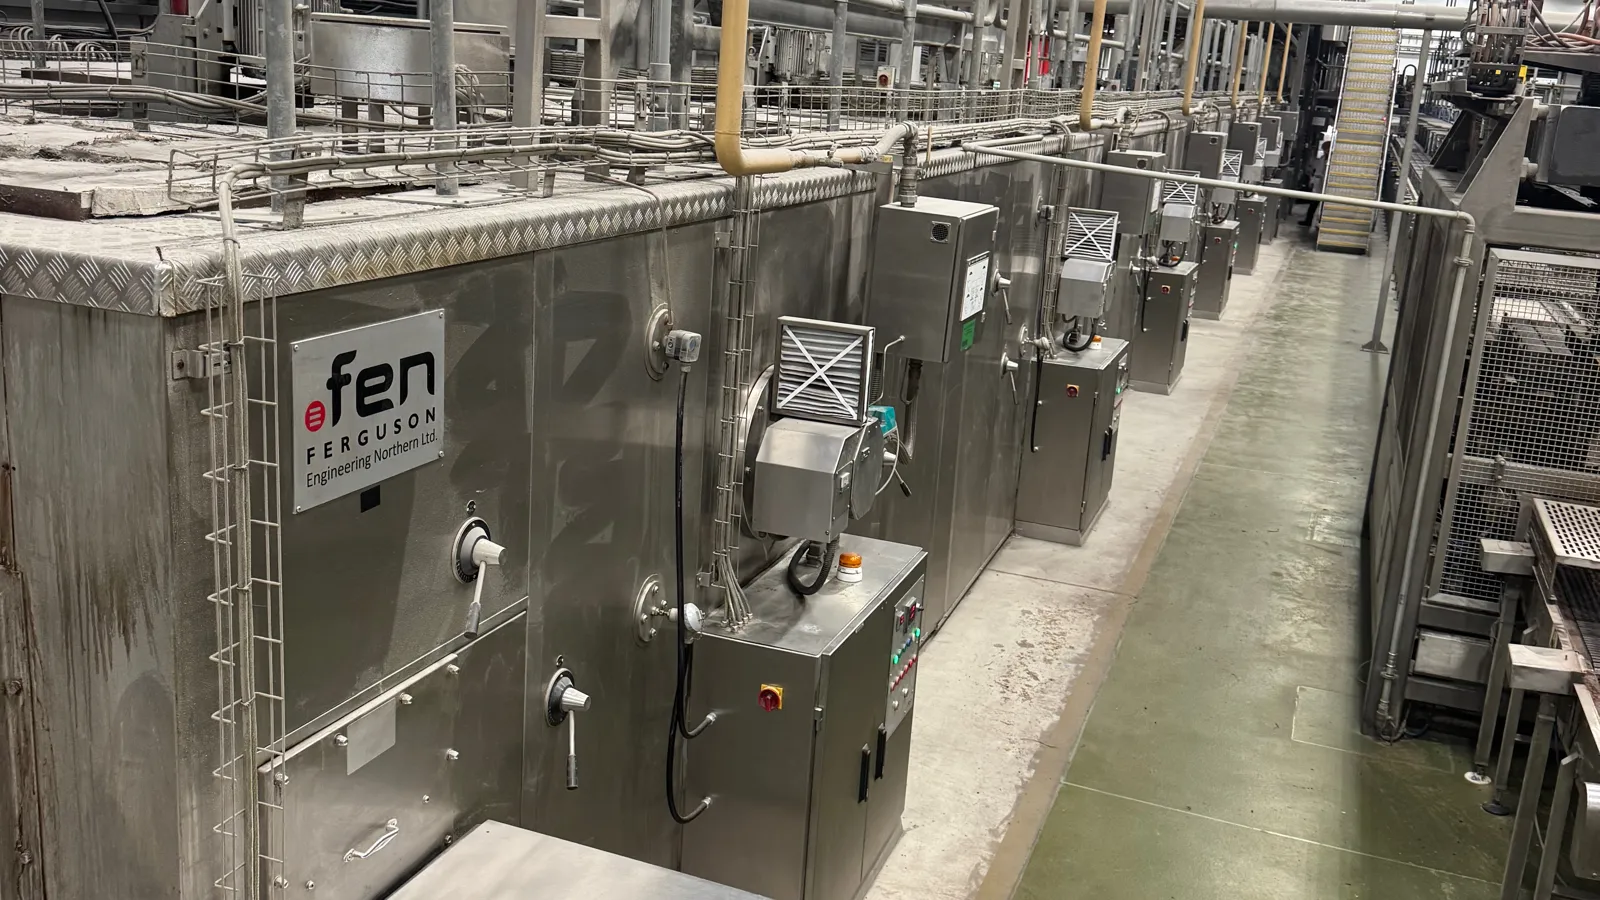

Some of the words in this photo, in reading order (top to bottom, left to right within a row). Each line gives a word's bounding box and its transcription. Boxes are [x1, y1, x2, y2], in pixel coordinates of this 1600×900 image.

[326, 350, 435, 427] fen
[306, 455, 371, 488] Engineering
[374, 436, 419, 464] Northern
[421, 429, 438, 446] Ltd.
[307, 407, 436, 465] FERGUSON
